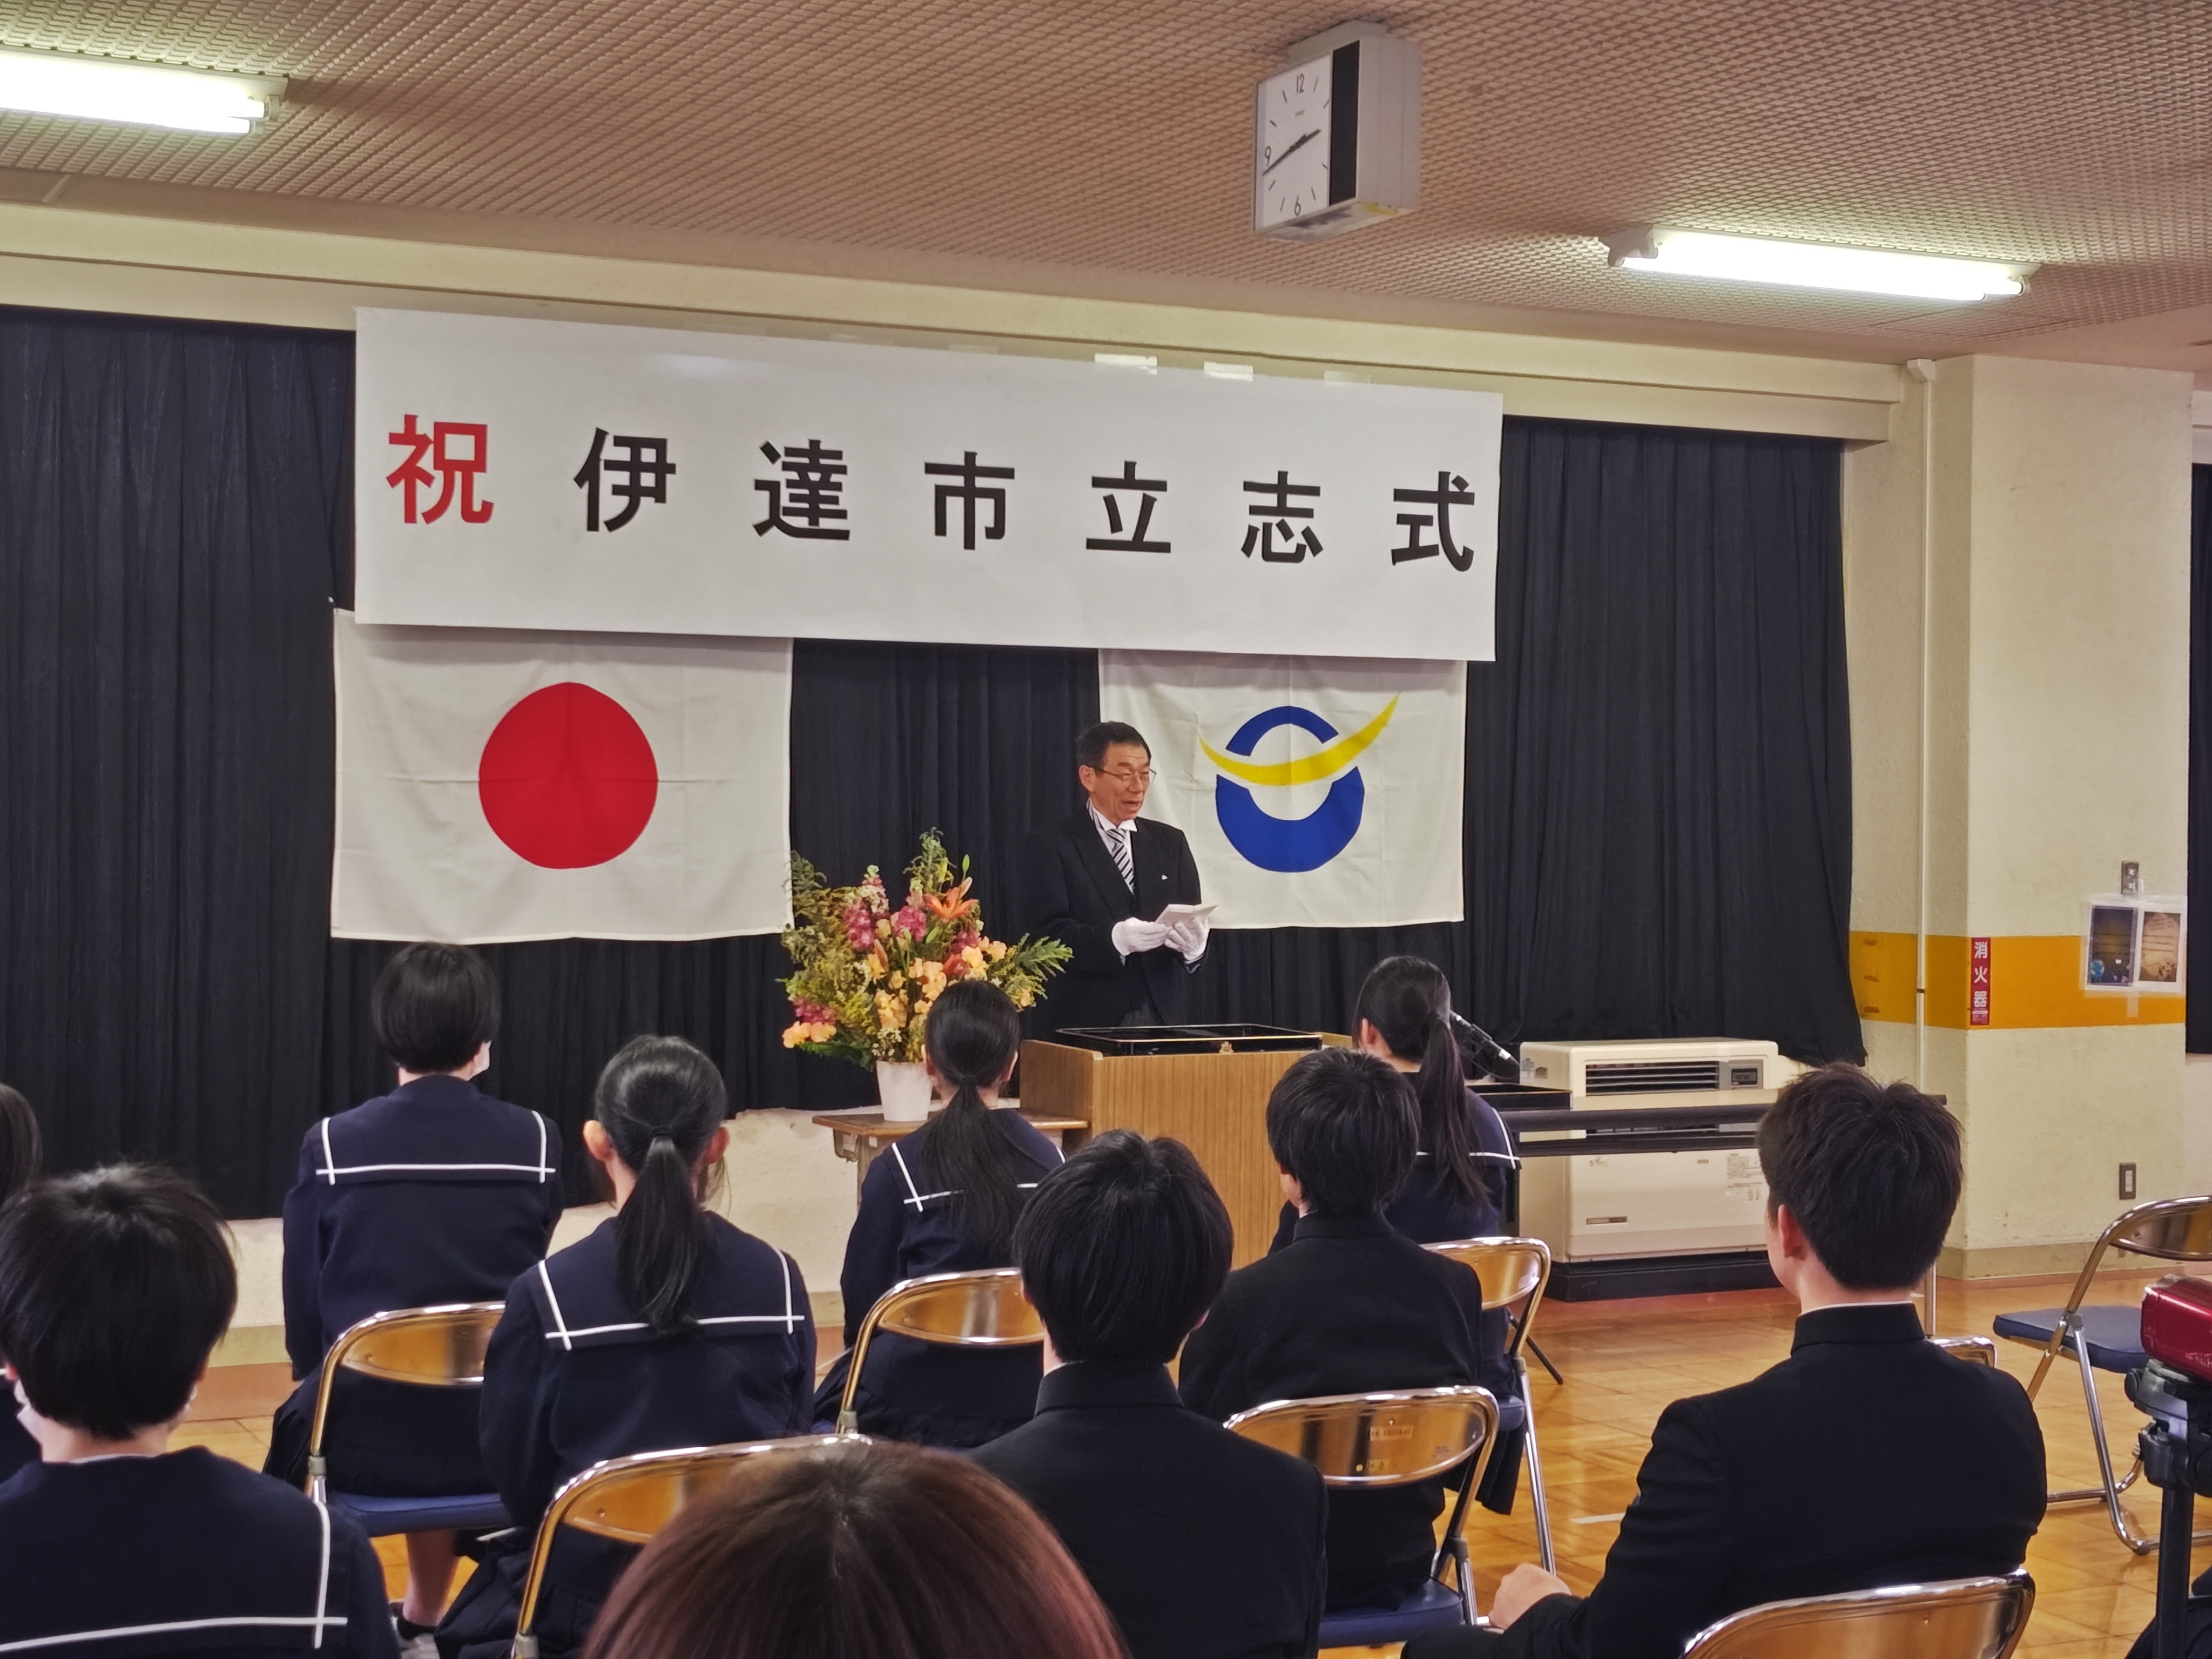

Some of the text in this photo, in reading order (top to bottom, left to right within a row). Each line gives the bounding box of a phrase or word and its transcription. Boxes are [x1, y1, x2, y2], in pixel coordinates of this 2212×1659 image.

[1296, 73, 1304, 94] 12
[1265, 145, 1271, 167] 9
[1294, 195, 1301, 216] 6
[1974, 941, 1988, 1008] 消火器
